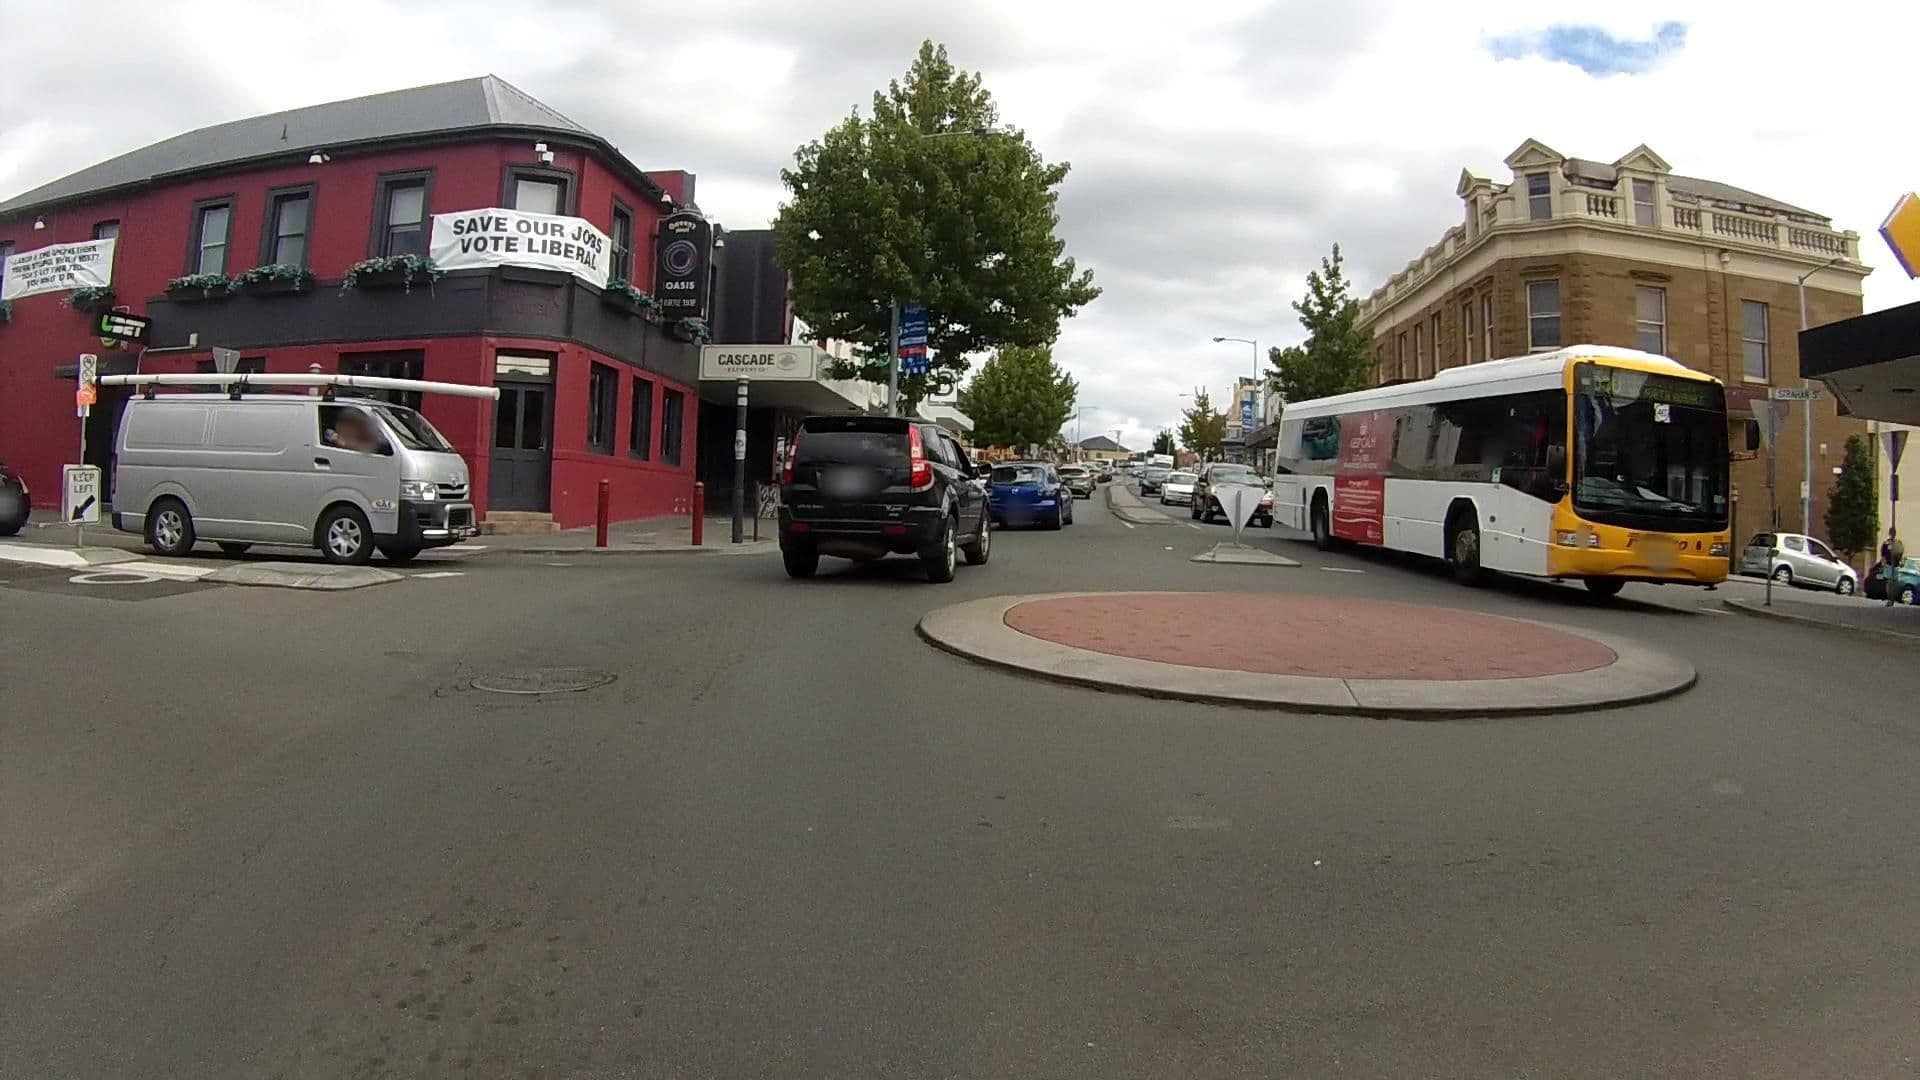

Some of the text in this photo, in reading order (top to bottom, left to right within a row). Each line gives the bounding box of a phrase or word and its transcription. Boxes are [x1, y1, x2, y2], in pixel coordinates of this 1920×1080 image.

[453, 215, 603, 254] SAVE OUR JOBS
[460, 236, 597, 270] VOTE LIBERAL
[665, 281, 696, 290] OASIS
[718, 354, 775, 366] CASCADE
[72, 472, 94, 483] KEEP
[73, 483, 93, 494] LEFT
